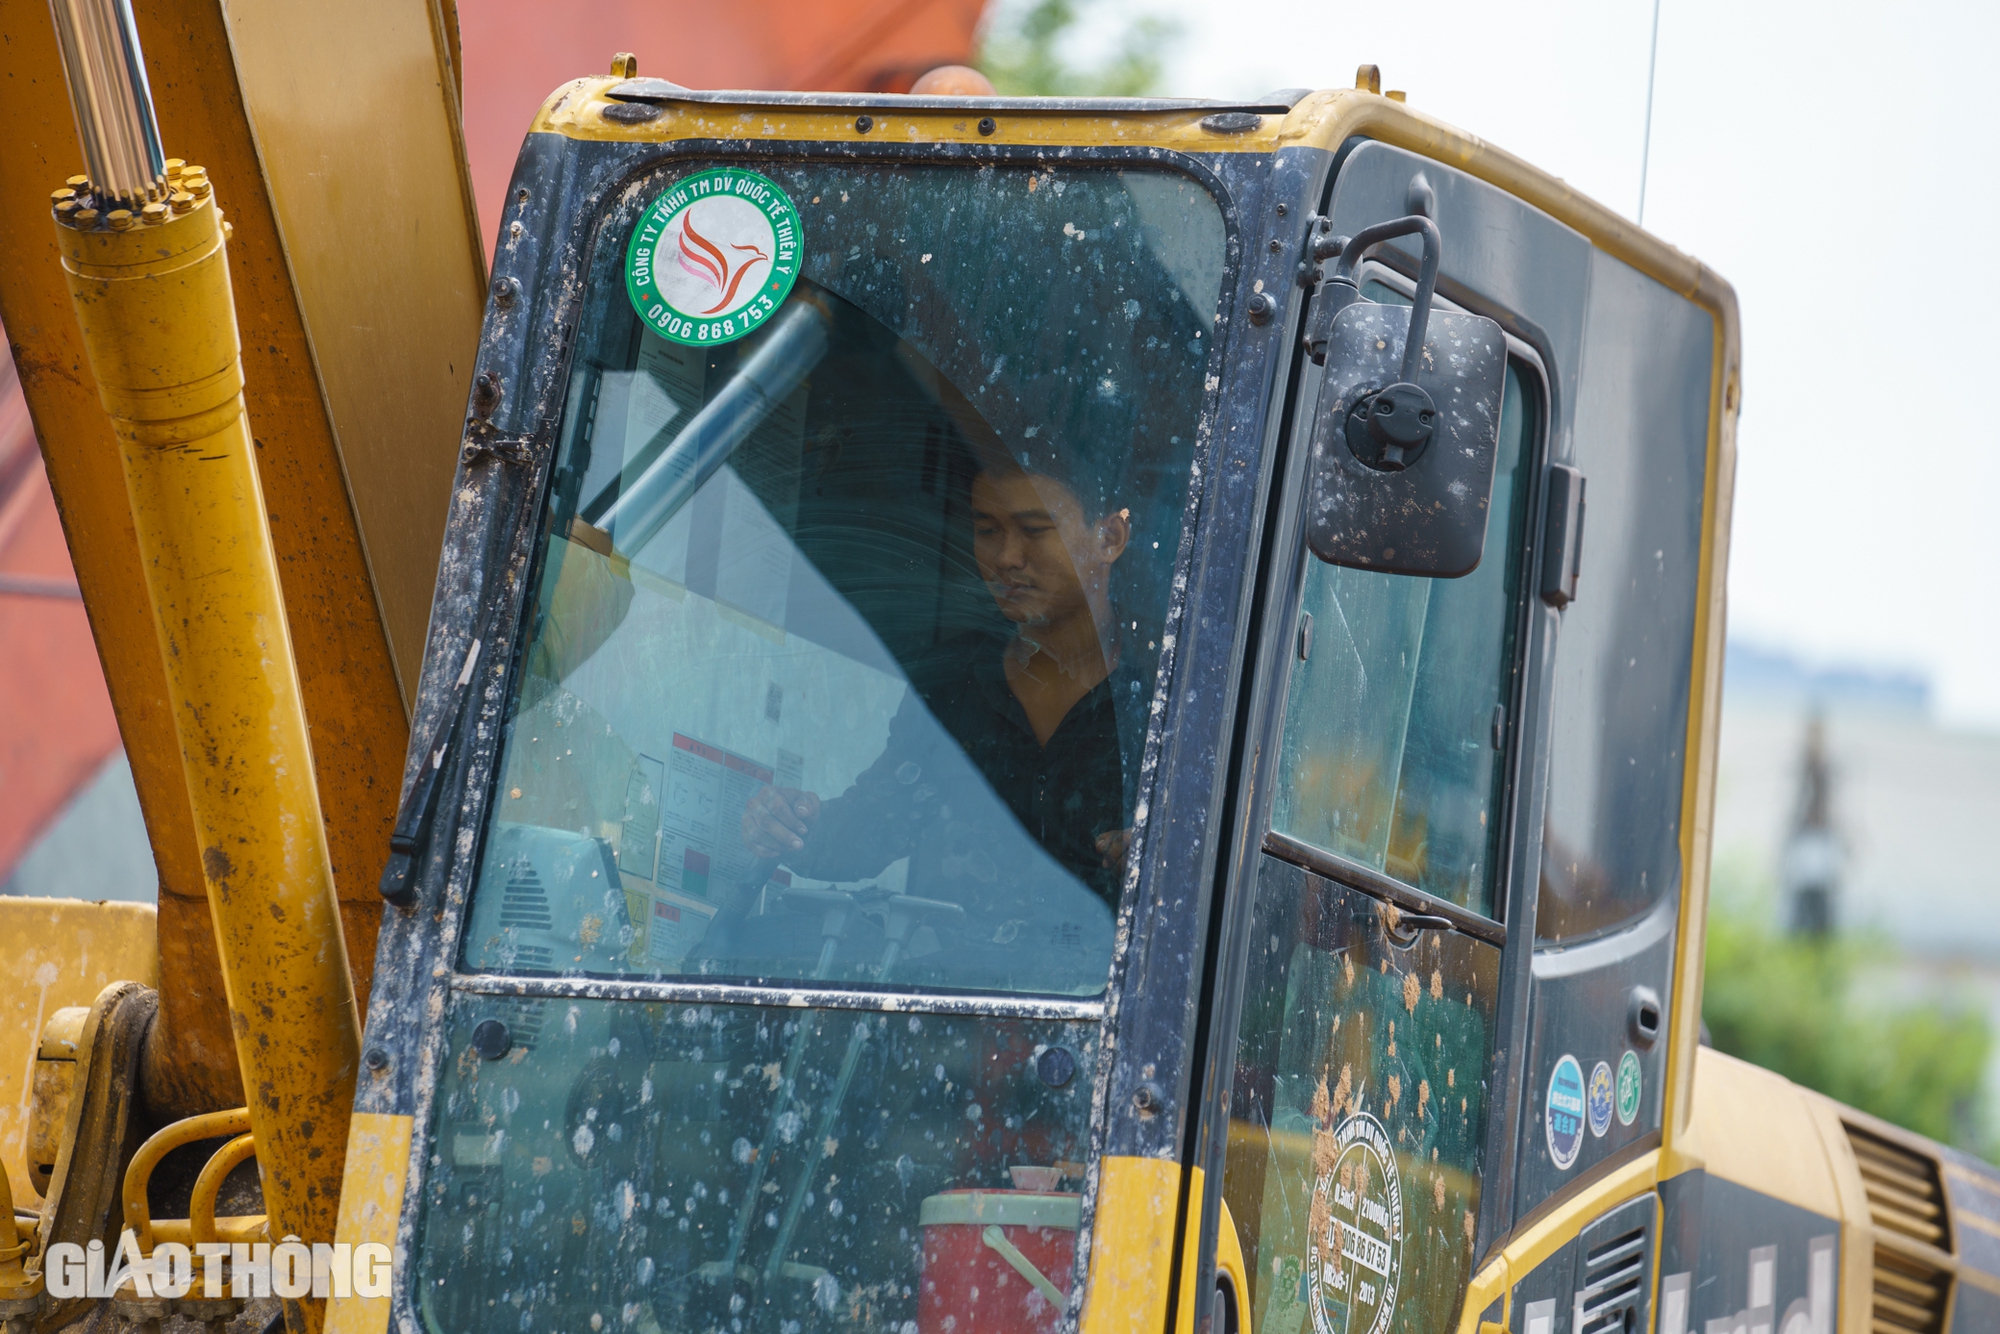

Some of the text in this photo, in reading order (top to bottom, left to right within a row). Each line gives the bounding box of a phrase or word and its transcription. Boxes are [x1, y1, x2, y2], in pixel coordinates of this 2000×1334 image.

[632, 177, 797, 286] CÔNG TY TNHH TM DV QUỐC TẾ THIÊN Ý
[648, 294, 774, 340] 0906 868 753
[1356, 1235, 1366, 1260] 86
[1366, 1240, 1376, 1265] 87
[1376, 1246, 1387, 1271] 53
[1359, 1280, 1376, 1306] 2013
